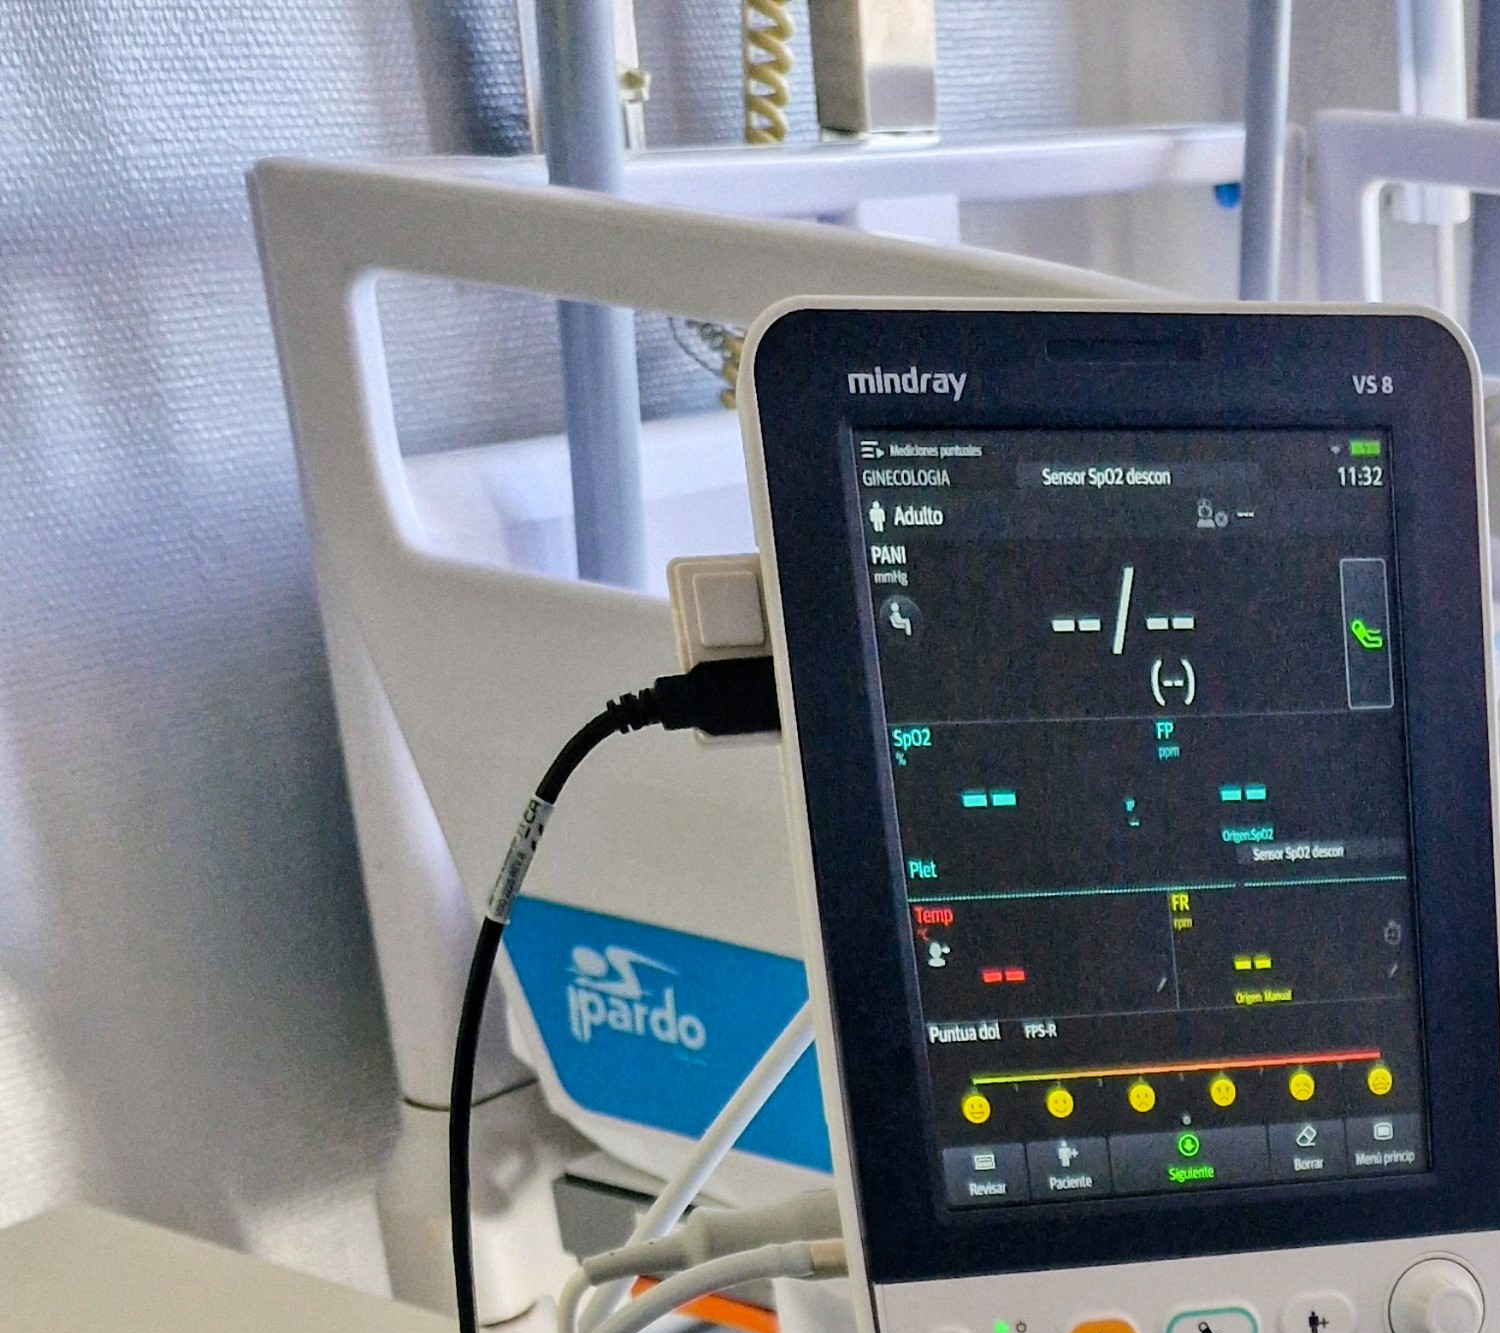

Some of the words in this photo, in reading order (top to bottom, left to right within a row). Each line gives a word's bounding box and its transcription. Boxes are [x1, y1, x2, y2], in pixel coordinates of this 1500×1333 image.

[847, 366, 967, 401] mindray
[1352, 374, 1378, 394] VS
[1381, 374, 1394, 394] 8
[889, 444, 938, 457] Mediciones
[940, 444, 982, 459] puntuales
[862, 469, 951, 487] GINECOLOGIA
[1042, 467, 1084, 487] Sensor
[1088, 467, 1122, 490] SpO2
[1126, 467, 1171, 486] descon
[1337, 465, 1383, 487] 11:32
[894, 505, 944, 526] Adulto
[871, 546, 907, 565] PANI
[874, 571, 909, 586] mmHg
[892, 728, 932, 750] SpO2
[1155, 722, 1174, 740] FP
[1157, 745, 1180, 760] ppm
[1252, 847, 1284, 861] Sensor
[1312, 845, 1344, 858] descon
[909, 859, 938, 879] Plet
[1171, 894, 1190, 912] FR
[914, 906, 953, 926] Temp
[1173, 916, 1193, 931] rpm
[929, 1024, 977, 1044] Puntua
[978, 1022, 1001, 1040] dol
[1024, 1022, 1058, 1039] FPS-R
[1294, 1156, 1324, 1171] Borrar
[1384, 1149, 1415, 1165] princip
[1168, 1163, 1215, 1180] Siguiente
[969, 1182, 1007, 1196] Revisar
[1049, 1175, 1093, 1190] Paciente
